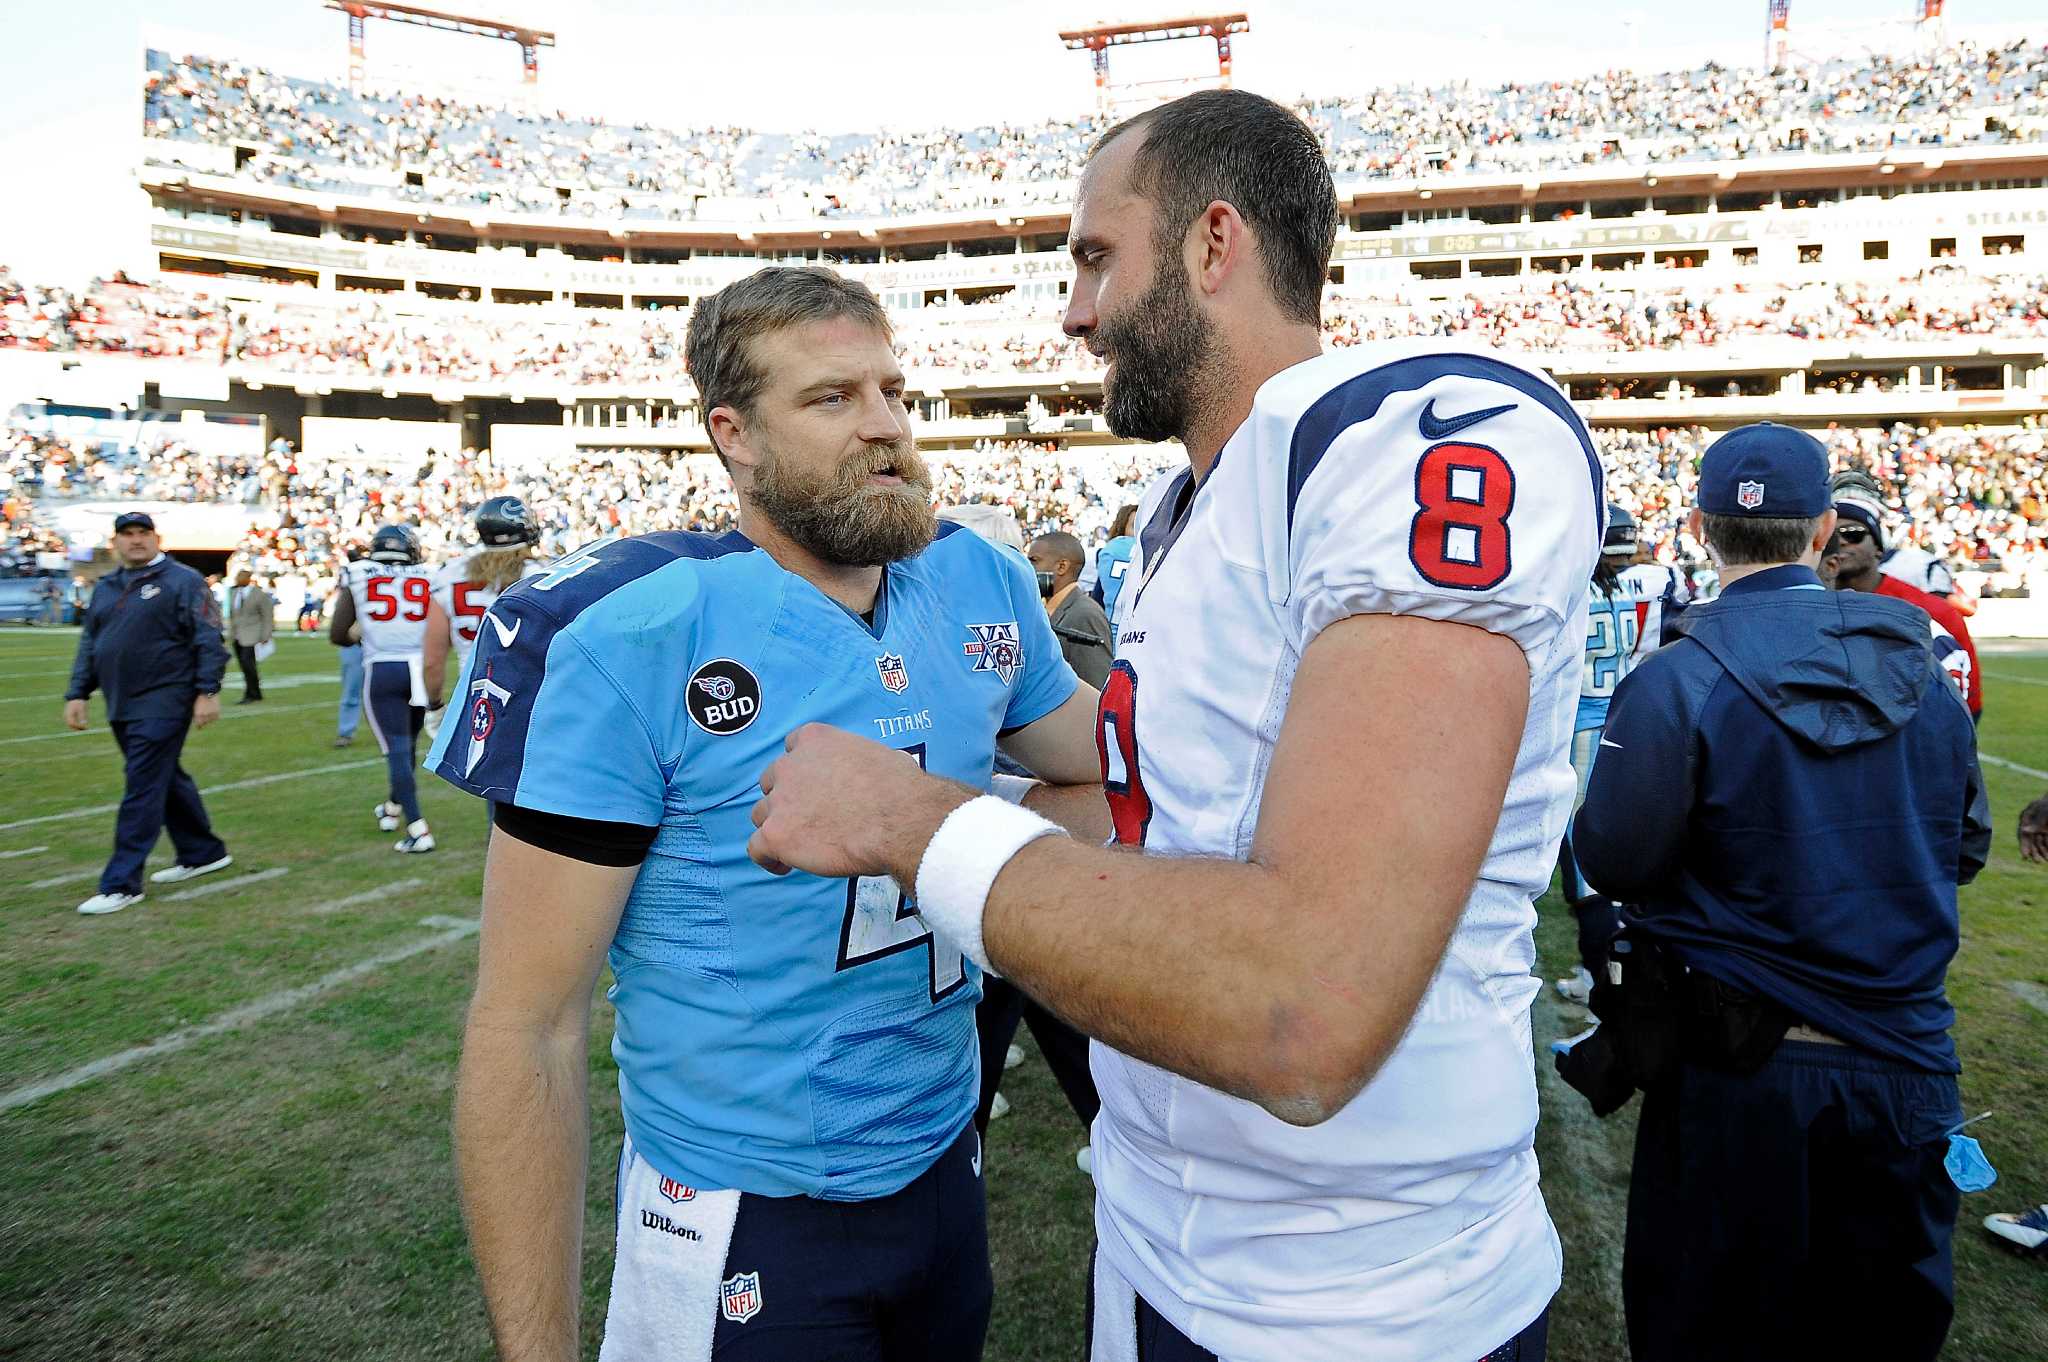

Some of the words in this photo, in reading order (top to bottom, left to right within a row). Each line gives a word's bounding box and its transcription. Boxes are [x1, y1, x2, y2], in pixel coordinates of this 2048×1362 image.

[1408, 440, 1516, 592] 8
[367, 577, 432, 622] 59
[880, 670, 905, 689] NFL
[703, 696, 755, 725] BUD
[874, 710, 932, 738] TITANS
[641, 1210, 702, 1241] Wilson
[727, 1293, 755, 1314] NFL
